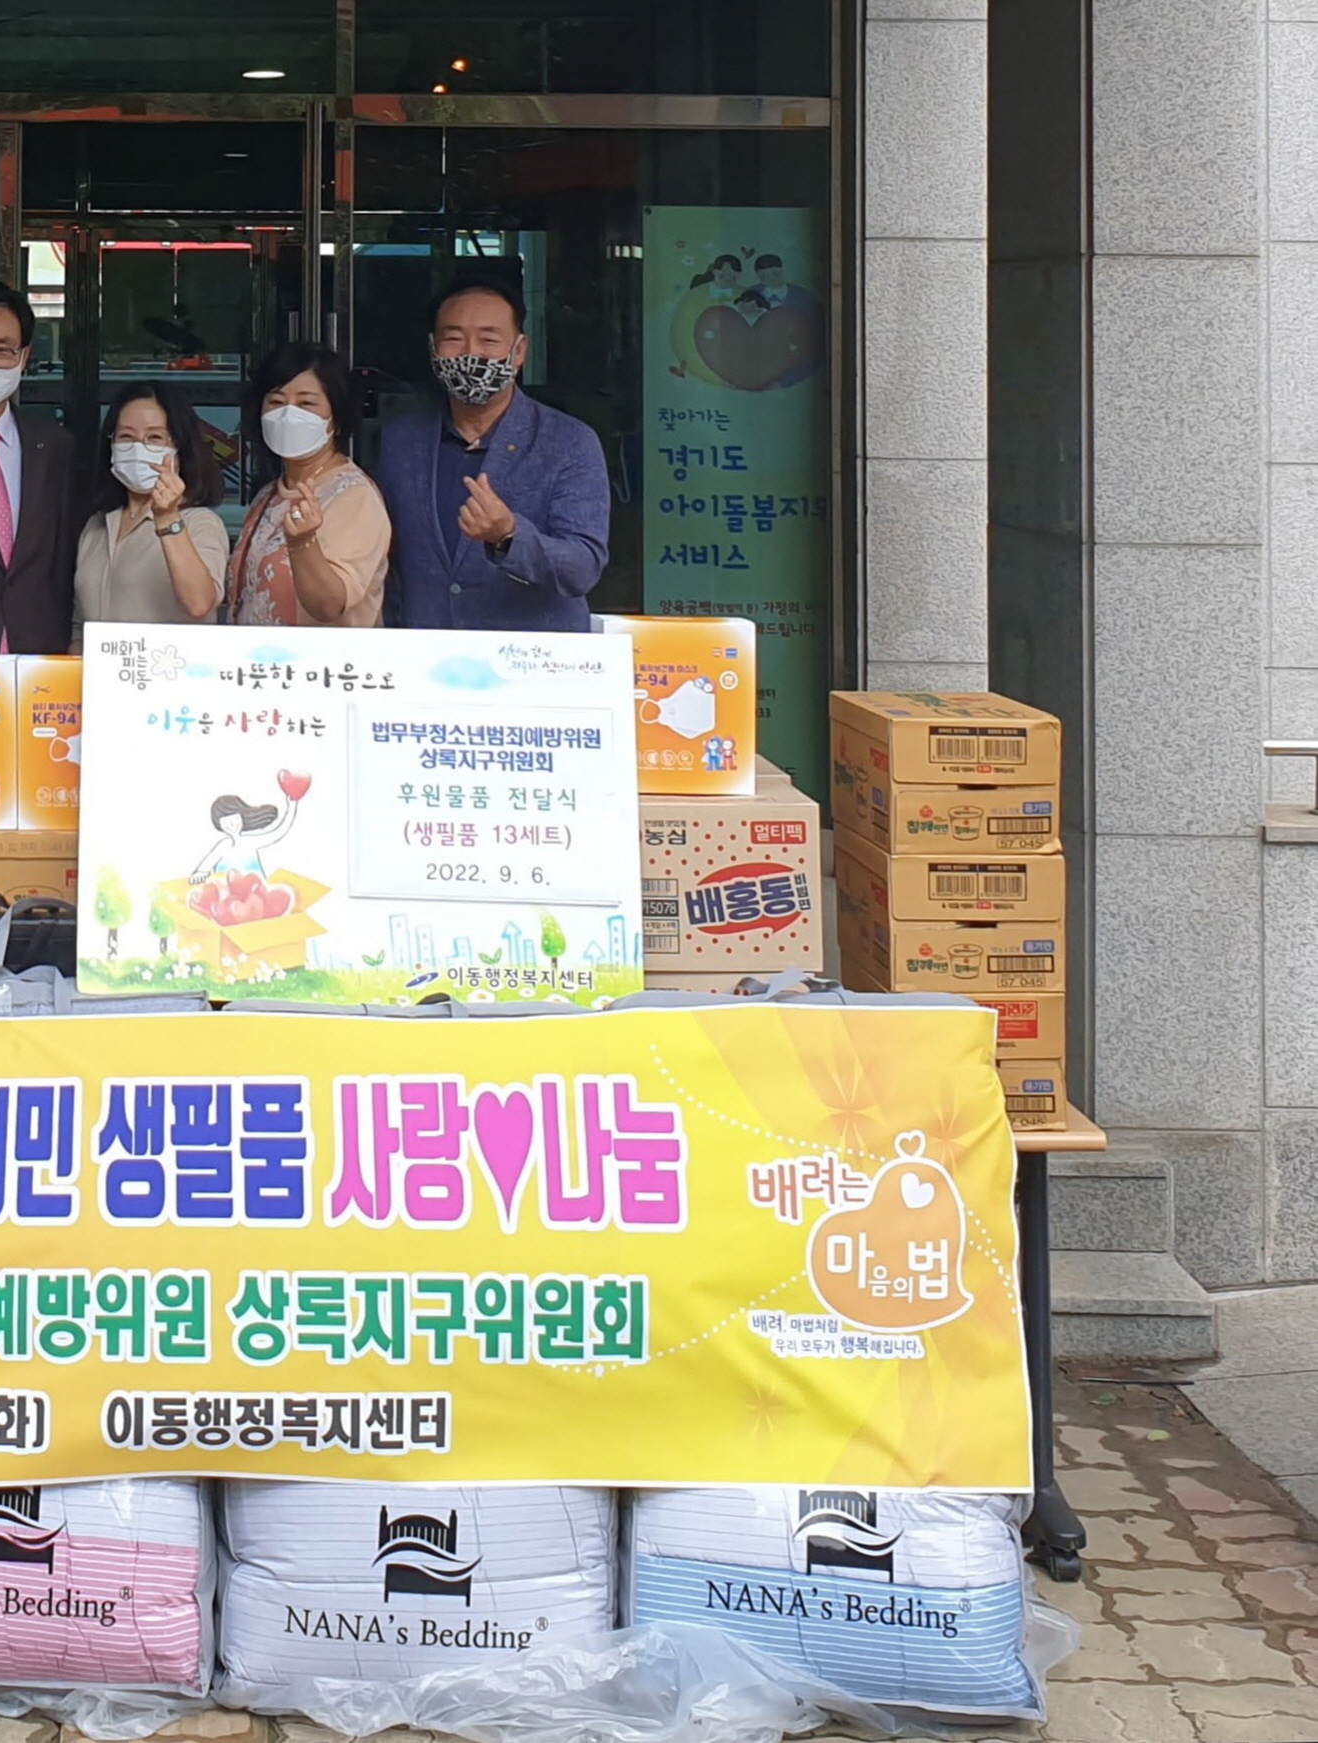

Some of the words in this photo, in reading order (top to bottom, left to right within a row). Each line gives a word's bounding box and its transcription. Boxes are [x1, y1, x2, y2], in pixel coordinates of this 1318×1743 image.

[658, 408, 731, 431] 찾아가는
[658, 446, 748, 481] 경기도
[658, 544, 749, 570] 서비스
[762, 601, 800, 616] 가정의
[101, 638, 147, 655] 매화가
[122, 657, 148, 668] 피는
[119, 669, 152, 690] 이동
[220, 663, 294, 690] 따뜻한
[306, 663, 395, 691] 마음으로
[634, 673, 669, 686] F-94
[33, 712, 77, 724] KF-94
[148, 706, 214, 734] 이웃을
[225, 708, 326, 737] 사랑하는
[419, 748, 554, 772] 상록지구위원회
[397, 783, 490, 809] 후원물품
[508, 787, 576, 811] 전달식
[403, 821, 478, 847] (생필품
[493, 824, 572, 850] 13세트)
[645, 829, 687, 846] 농심
[754, 825, 803, 842] 멀티팩
[427, 863, 486, 884] 2022.
[499, 865, 519, 885] 9.
[532, 867, 551, 886] 6.
[685, 875, 796, 925] 배홍동
[447, 967, 593, 990] 이동행정복지센터
[98, 1084, 307, 1219] 생필품
[752, 1157, 869, 1220] 배려는
[232, 1276, 644, 1361] 상록지구위원회
[790, 1317, 839, 1333] 마법처럼
[775, 1339, 797, 1352] 우리
[801, 1339, 835, 1352] 모두가
[840, 1336, 921, 1354] 행복해집니다.
[106, 1395, 447, 1451] 이동행정복지센터
[705, 1581, 833, 1620] NANA's
[284, 1605, 408, 1645] NANA's
